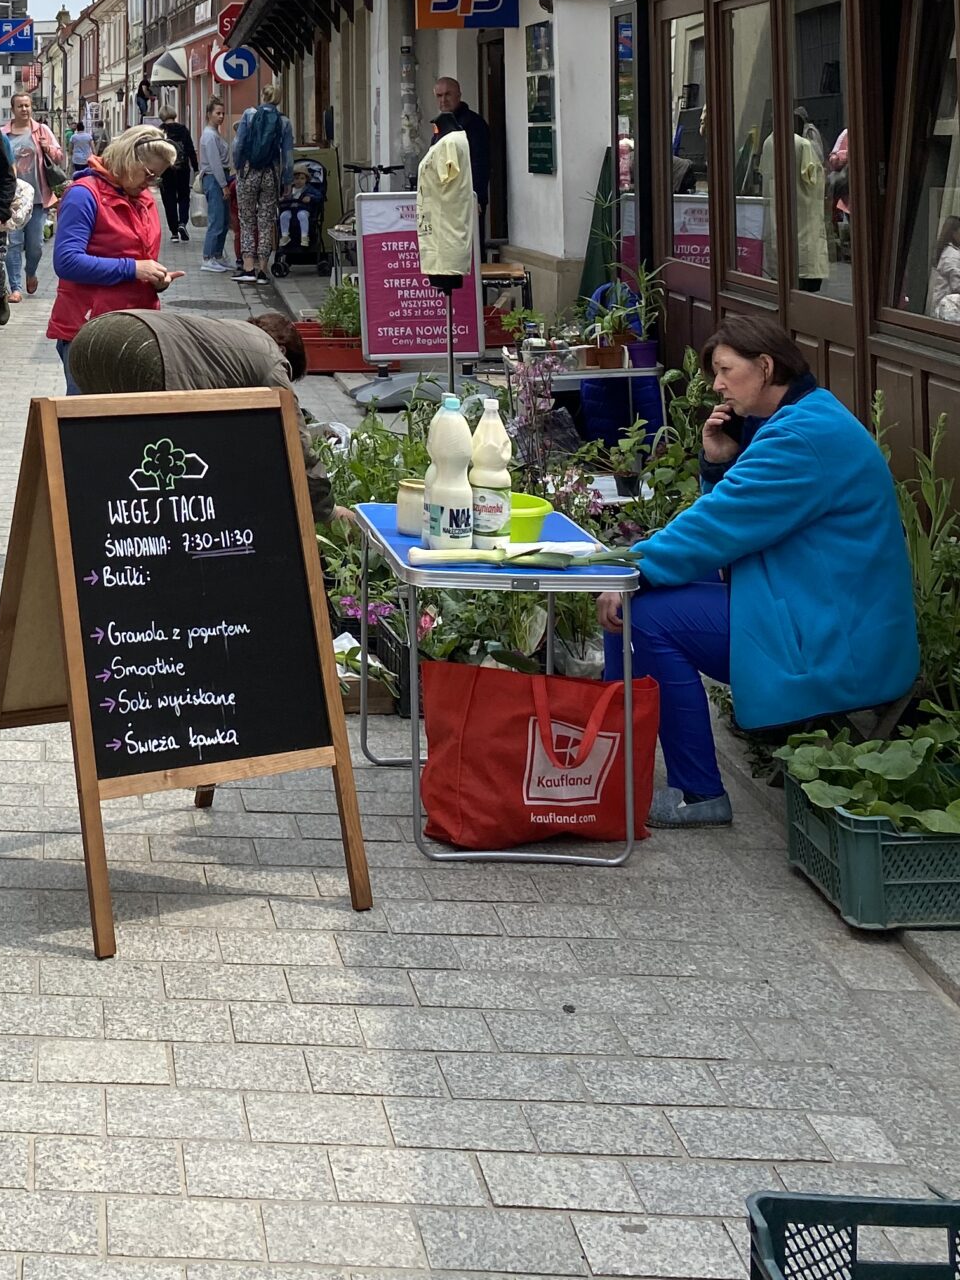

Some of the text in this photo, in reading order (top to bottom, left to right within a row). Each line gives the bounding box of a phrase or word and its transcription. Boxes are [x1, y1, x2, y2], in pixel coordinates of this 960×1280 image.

[382, 242, 417, 252] STREFA
[398, 252, 418, 260] WSZY
[388, 260, 398, 268] od
[401, 260, 411, 268] 15
[384, 278, 418, 288] STREFA
[400, 300, 442, 308] WSZYSTKO
[424, 308, 434, 316] do
[437, 308, 446, 316] 50
[378, 326, 412, 336] STREFA
[392, 336, 458, 346] Ceny Regulare
[104, 529, 253, 558] ŚNIADANIA: 7:30-11:30
[103, 565, 151, 587] Bułki:
[108, 620, 250, 648] Granola z jogurtem
[111, 656, 186, 679] Smoothie
[118, 688, 236, 717] Soki wyciskane
[124, 722, 240, 755] Świeża kawka
[536, 774, 592, 788] Kaufland
[530, 812, 596, 824] kaufland.com
